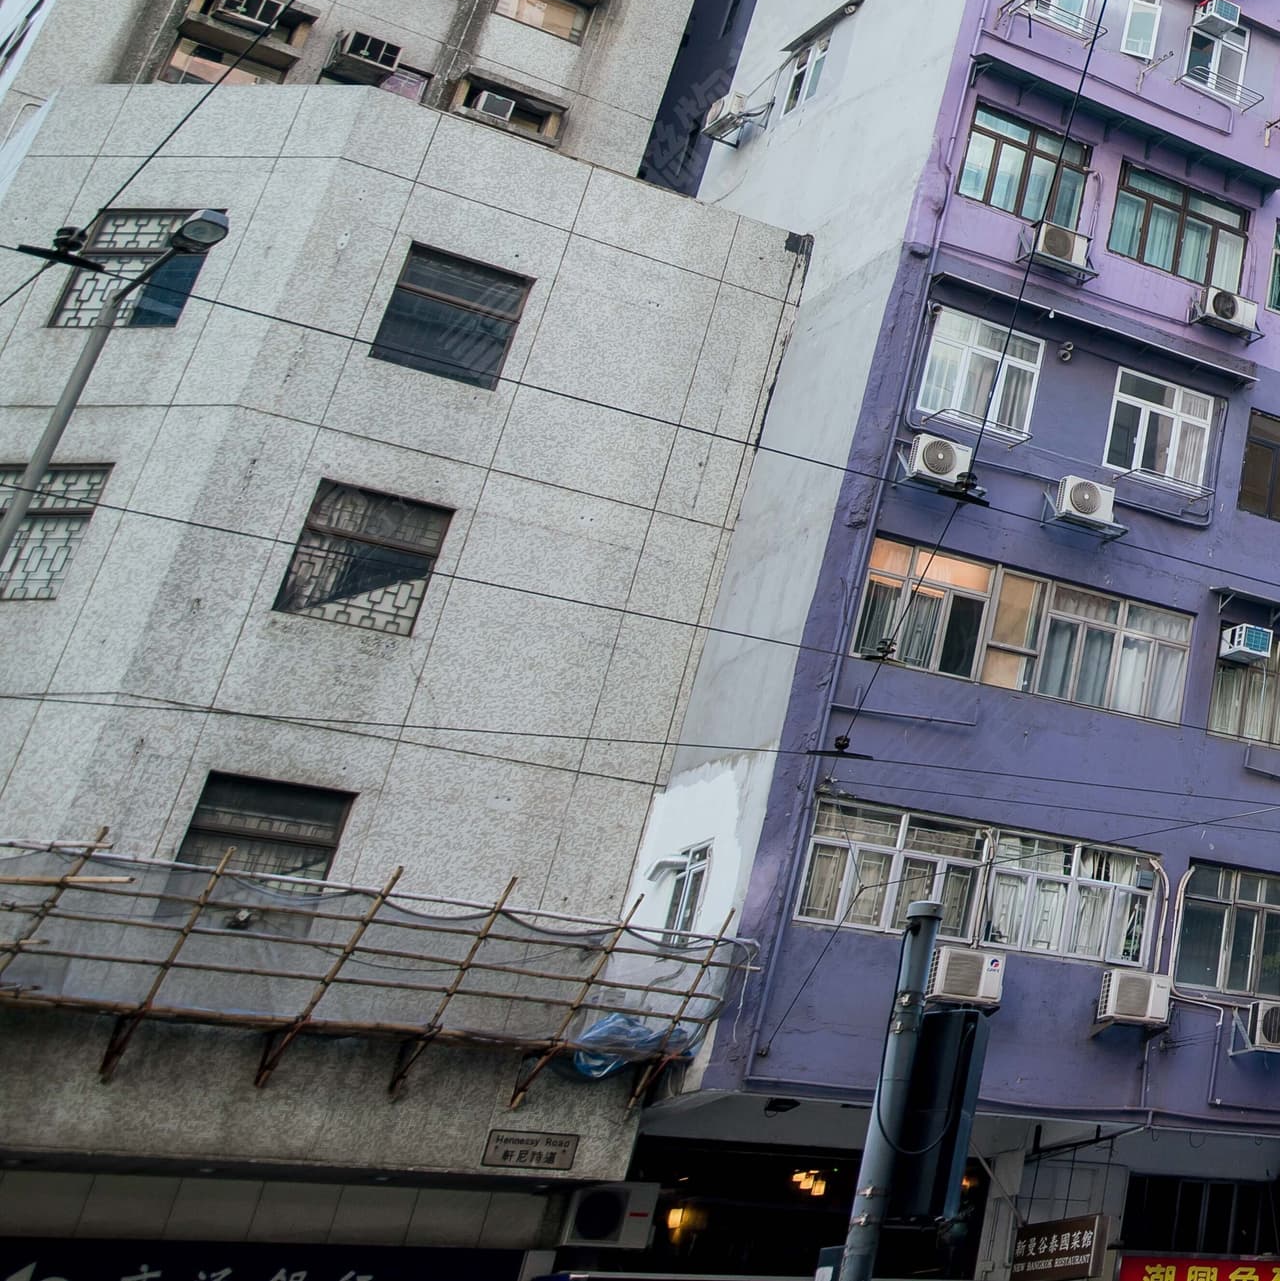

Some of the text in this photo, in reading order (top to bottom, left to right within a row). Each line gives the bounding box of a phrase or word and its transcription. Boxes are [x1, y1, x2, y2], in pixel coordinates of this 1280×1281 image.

[495, 1134, 570, 1148] Hennessy Road
[502, 1149, 558, 1165] 軒尼詩道
[1013, 1253, 1091, 1273] NEW BANGKOK RESTAURANT
